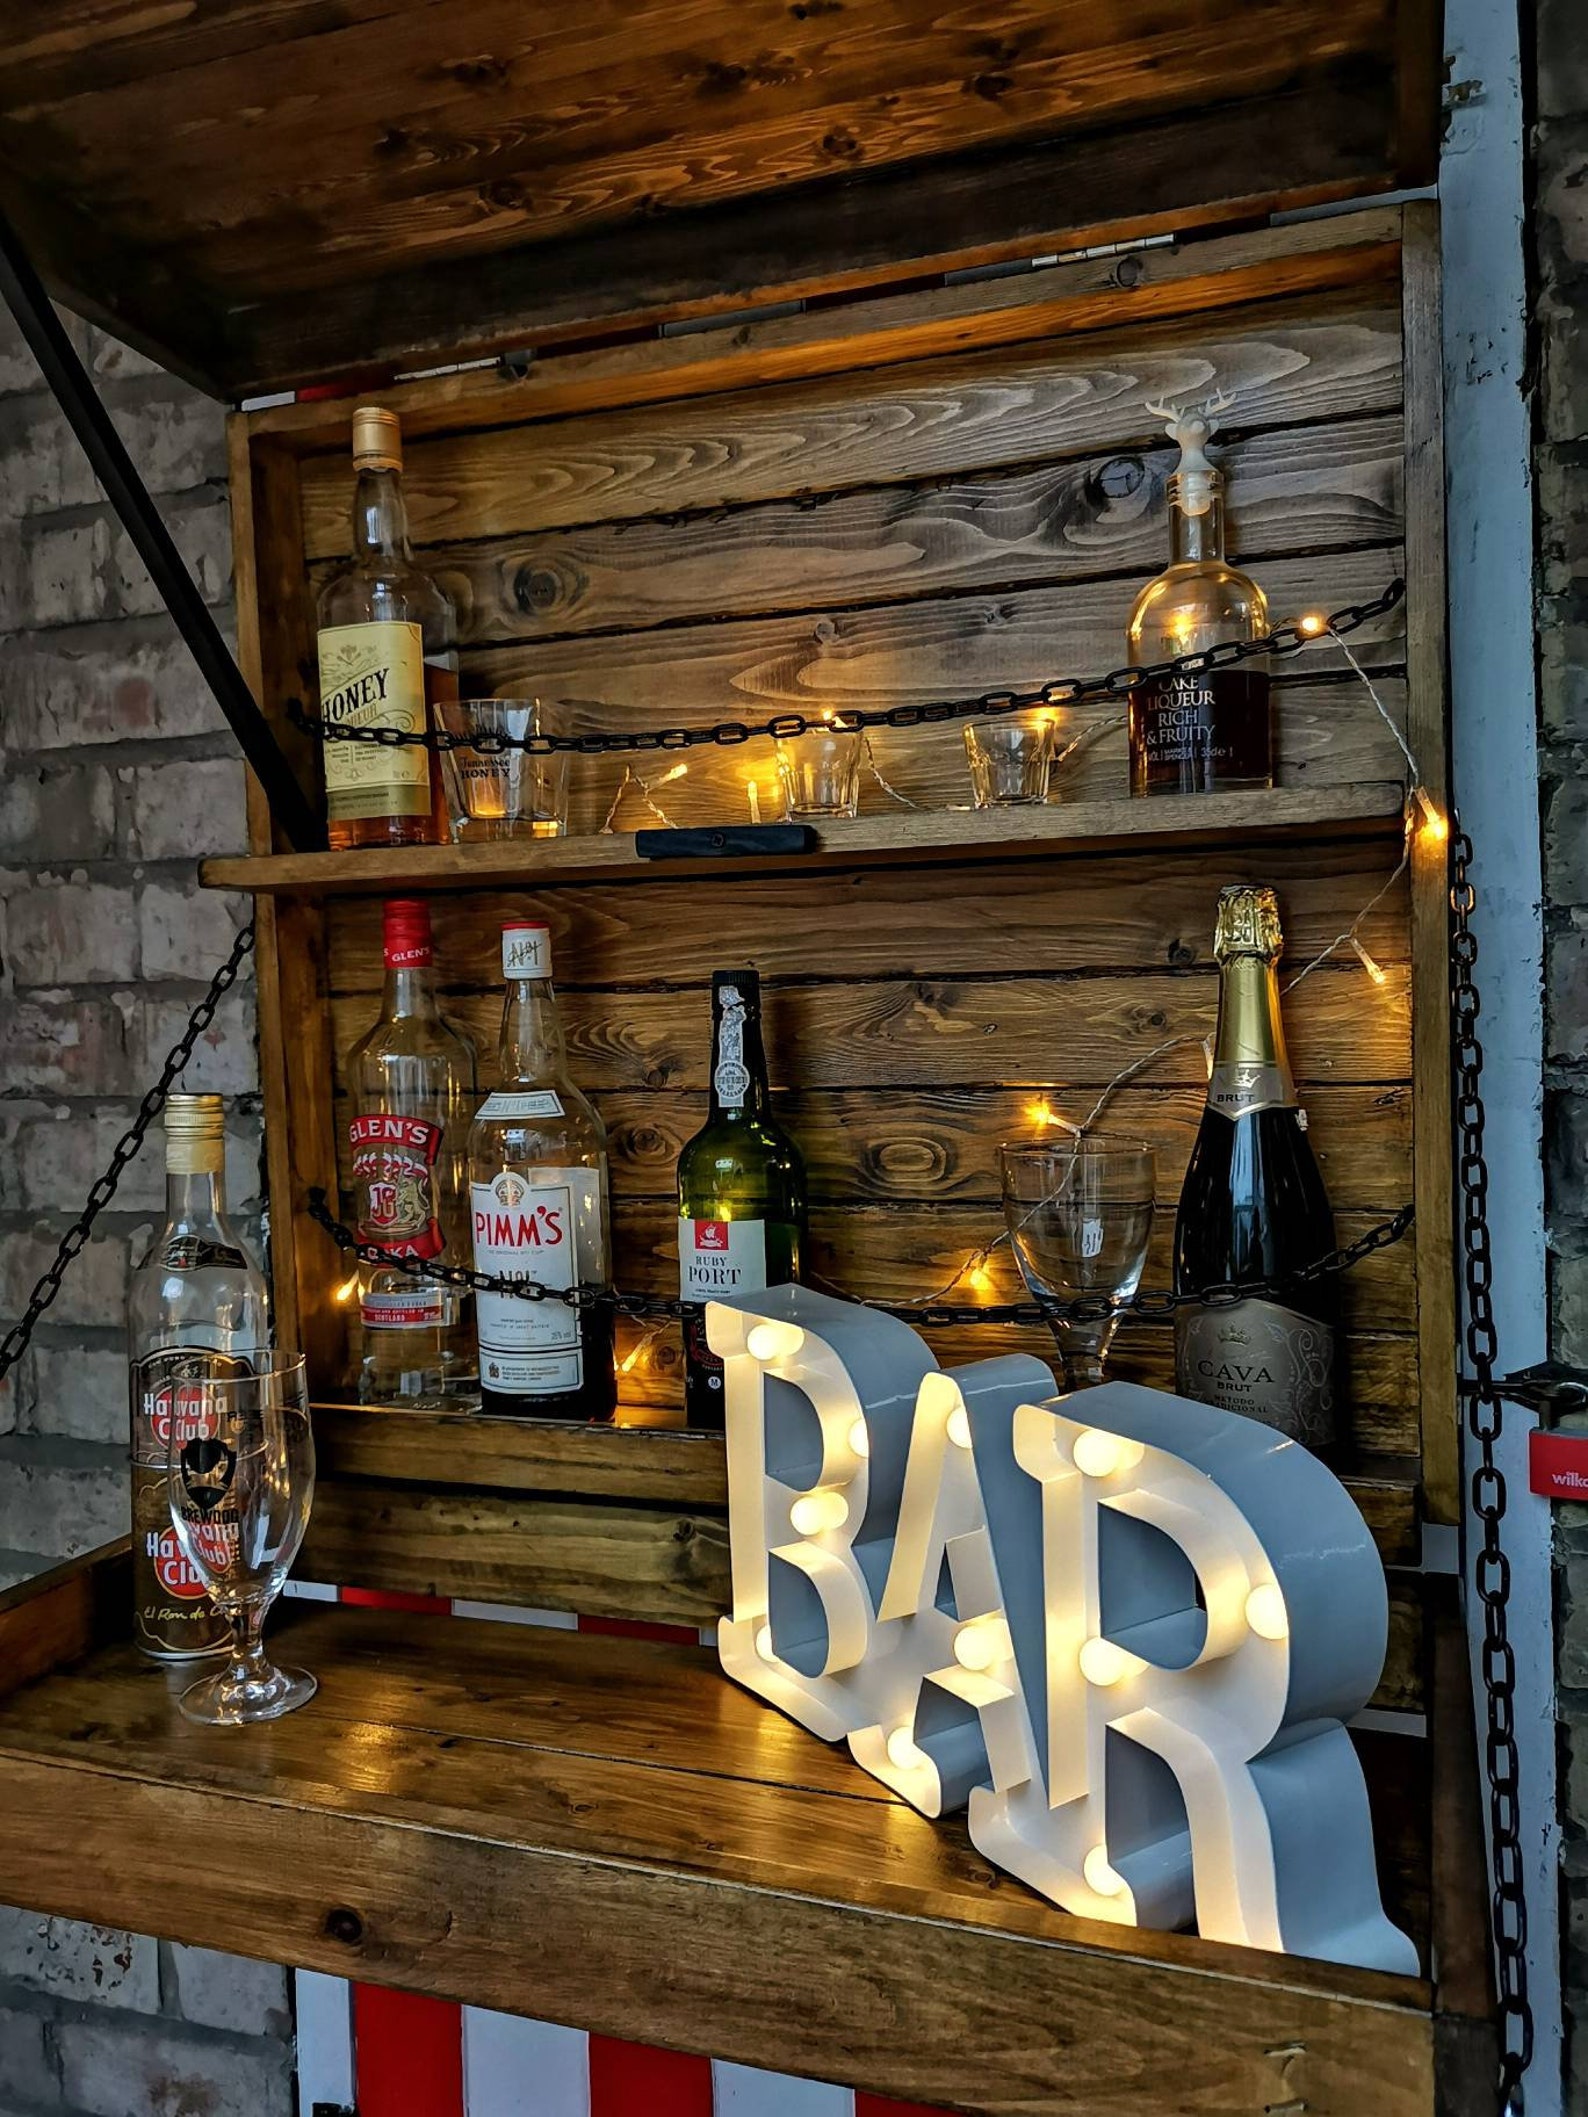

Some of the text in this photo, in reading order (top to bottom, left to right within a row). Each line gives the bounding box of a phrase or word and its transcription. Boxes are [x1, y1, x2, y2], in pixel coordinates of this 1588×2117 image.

[322, 667, 389, 722] HONEY
[1148, 690, 1216, 711] LIQUEUR
[1158, 709, 1198, 727] RICH
[1147, 725, 1216, 745] & FRUITY
[391, 946, 430, 962] GLEN'S
[1216, 1093, 1255, 1103] BRUT
[349, 1119, 430, 1145] GLEN'S
[475, 1206, 563, 1247] PIMM'S
[695, 1255, 728, 1267] RUBY
[688, 1266, 742, 1285] PORT
[1197, 1360, 1275, 1383] CAVA
[1217, 1381, 1252, 1393] BRUT
[706, 1284, 1420, 1973] BAR
